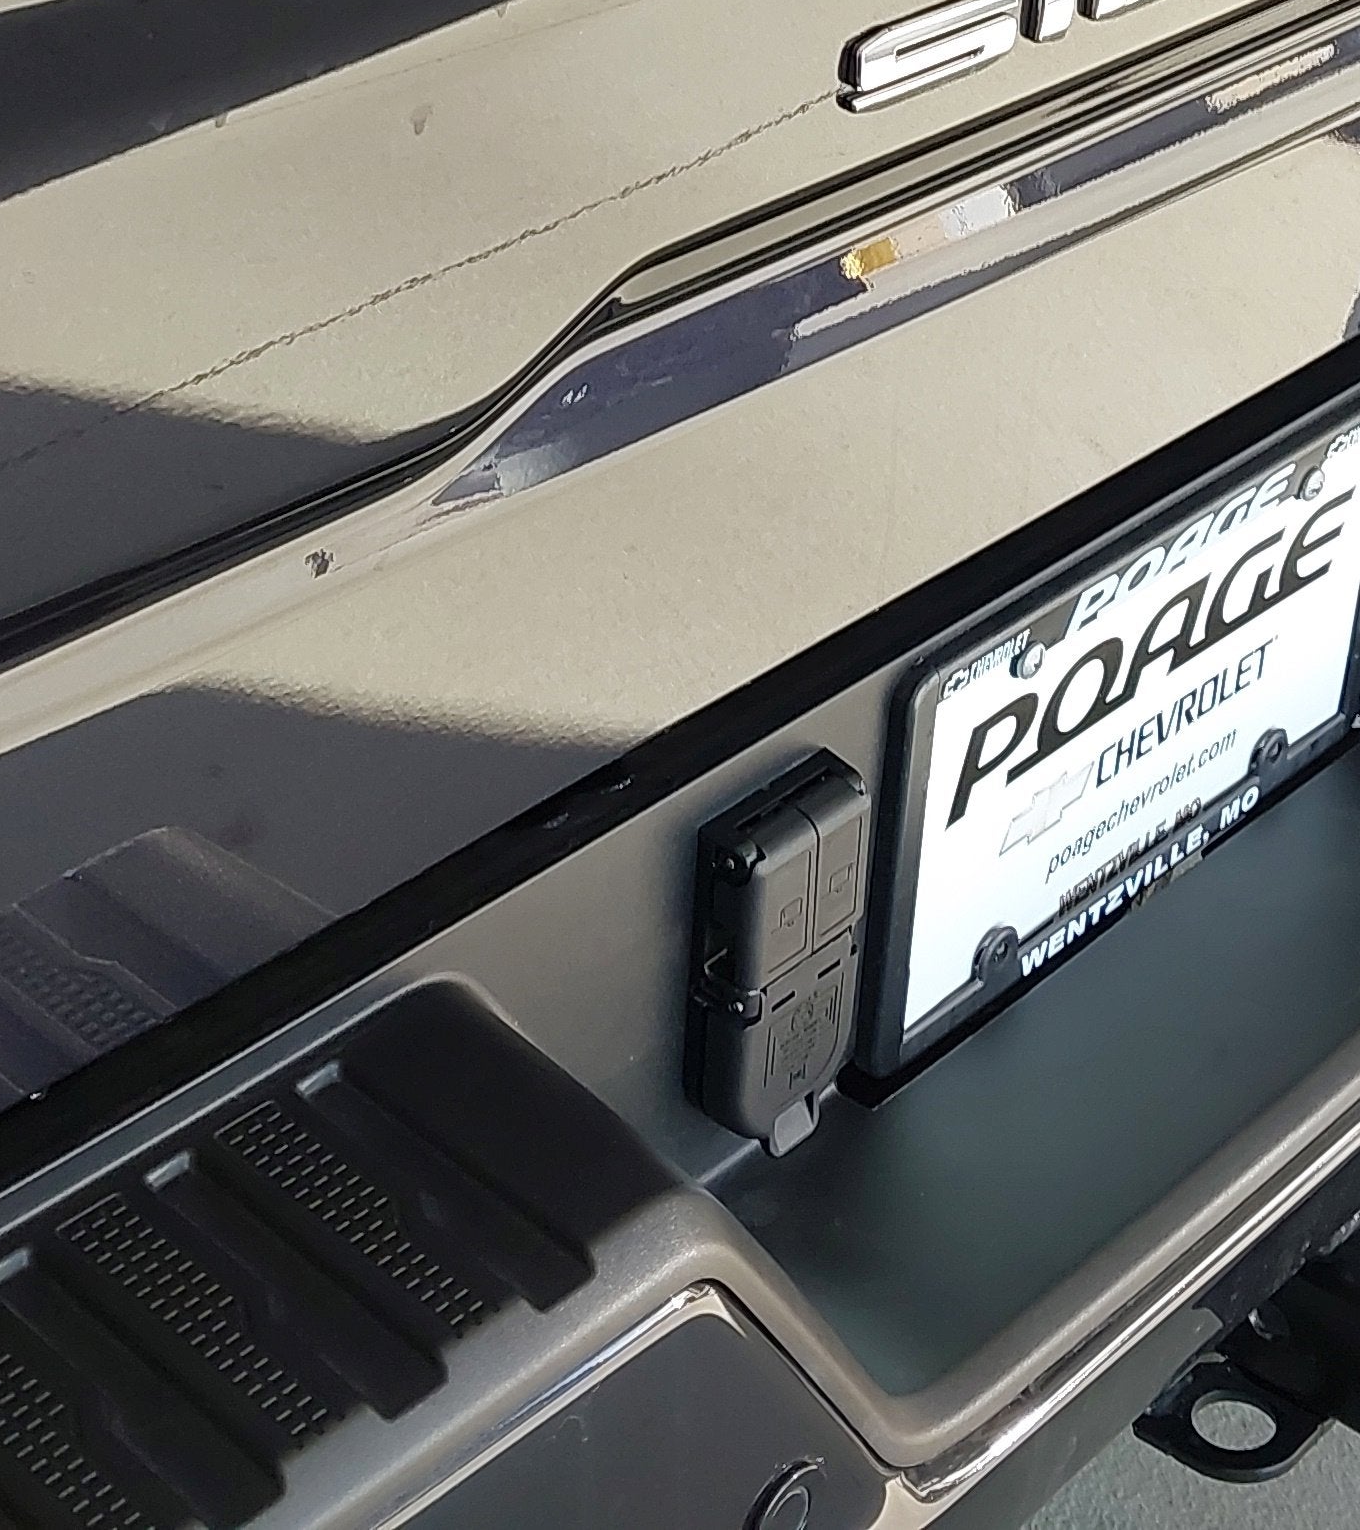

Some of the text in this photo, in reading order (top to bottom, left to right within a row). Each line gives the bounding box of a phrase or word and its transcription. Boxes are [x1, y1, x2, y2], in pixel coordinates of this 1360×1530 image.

[1064, 462, 1297, 639] POAGE
[945, 483, 1357, 831] POAGE
[1095, 638, 1274, 789] CHEVROLET
[1020, 784, 1261, 977] WENTZVILLE, MO
[1044, 728, 1237, 885] poagechevrolet.com
